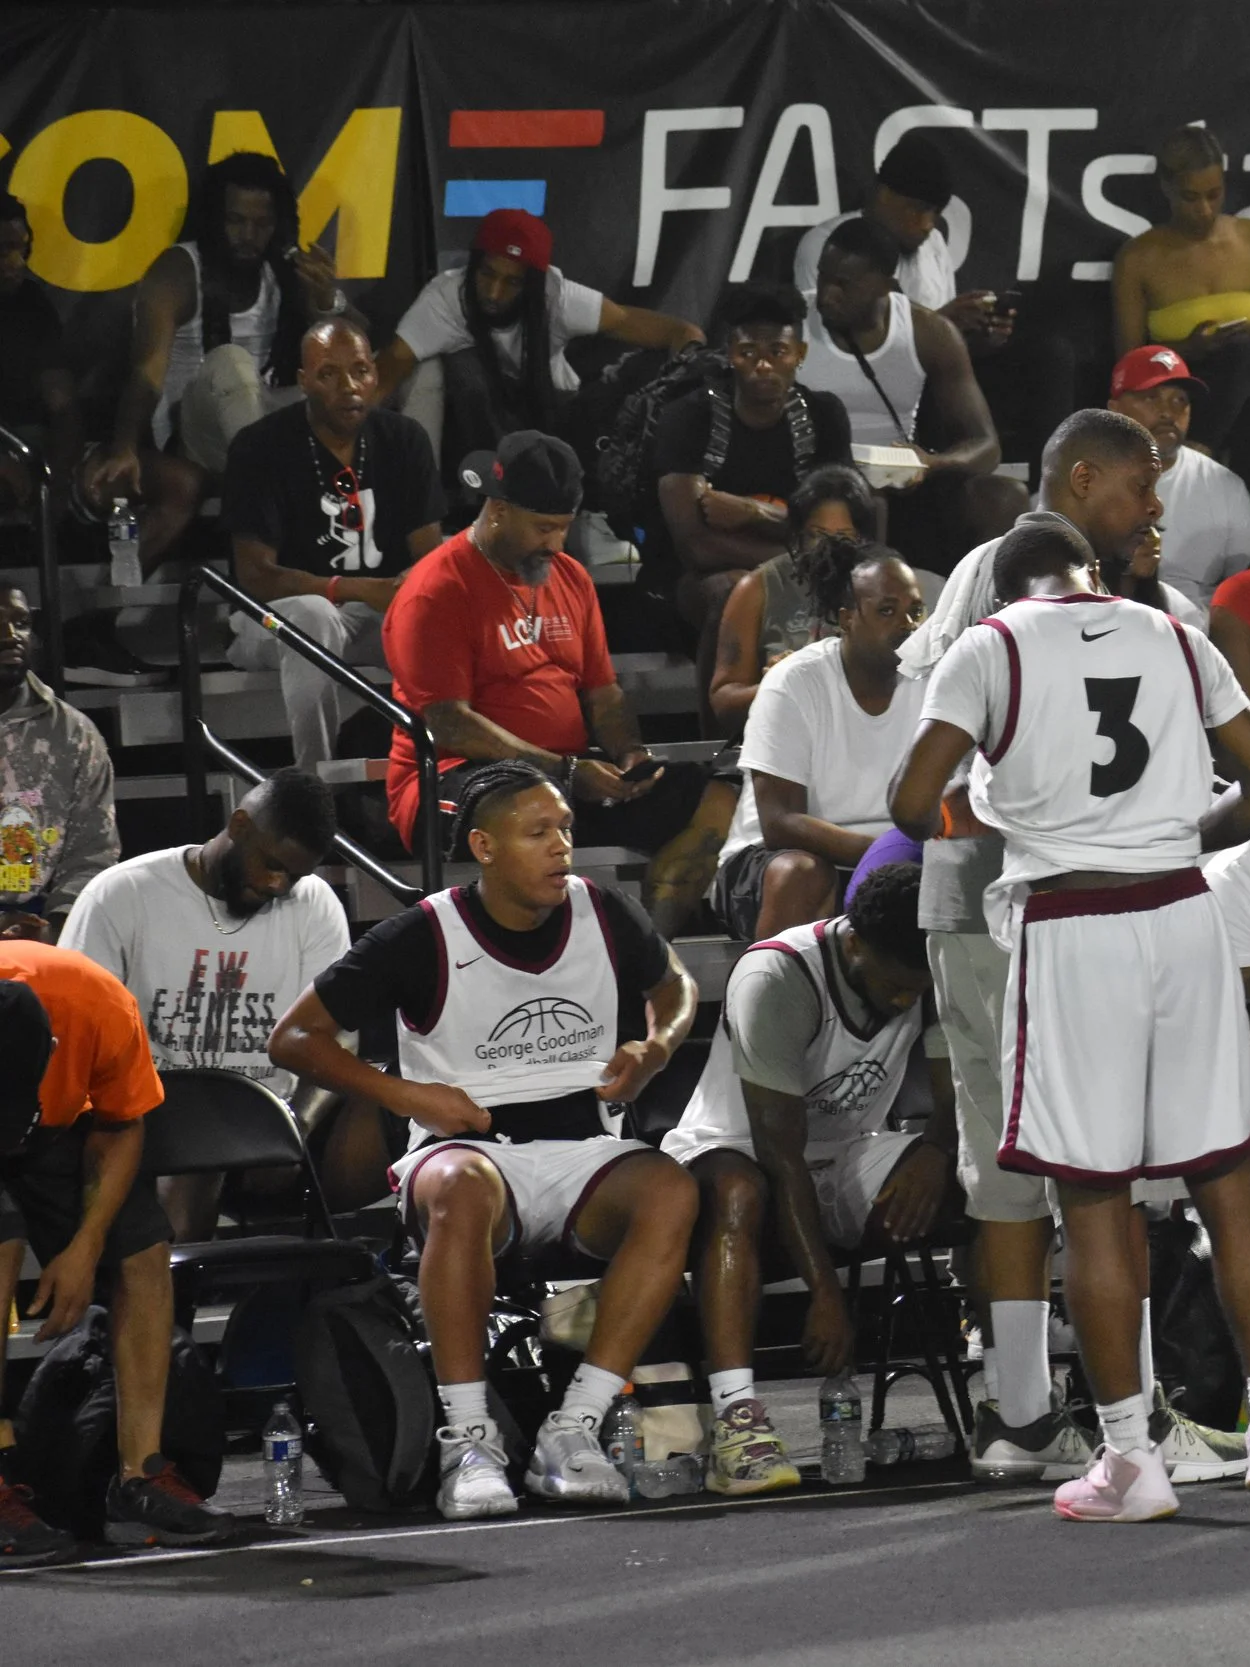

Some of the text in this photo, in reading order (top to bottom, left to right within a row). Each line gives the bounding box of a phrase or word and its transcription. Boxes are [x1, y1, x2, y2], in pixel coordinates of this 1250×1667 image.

[0, 107, 402, 292] OM
[1083, 675, 1150, 798] 3
[475, 1024, 604, 1060] George Goodman
[559, 1045, 597, 1063] Classic
